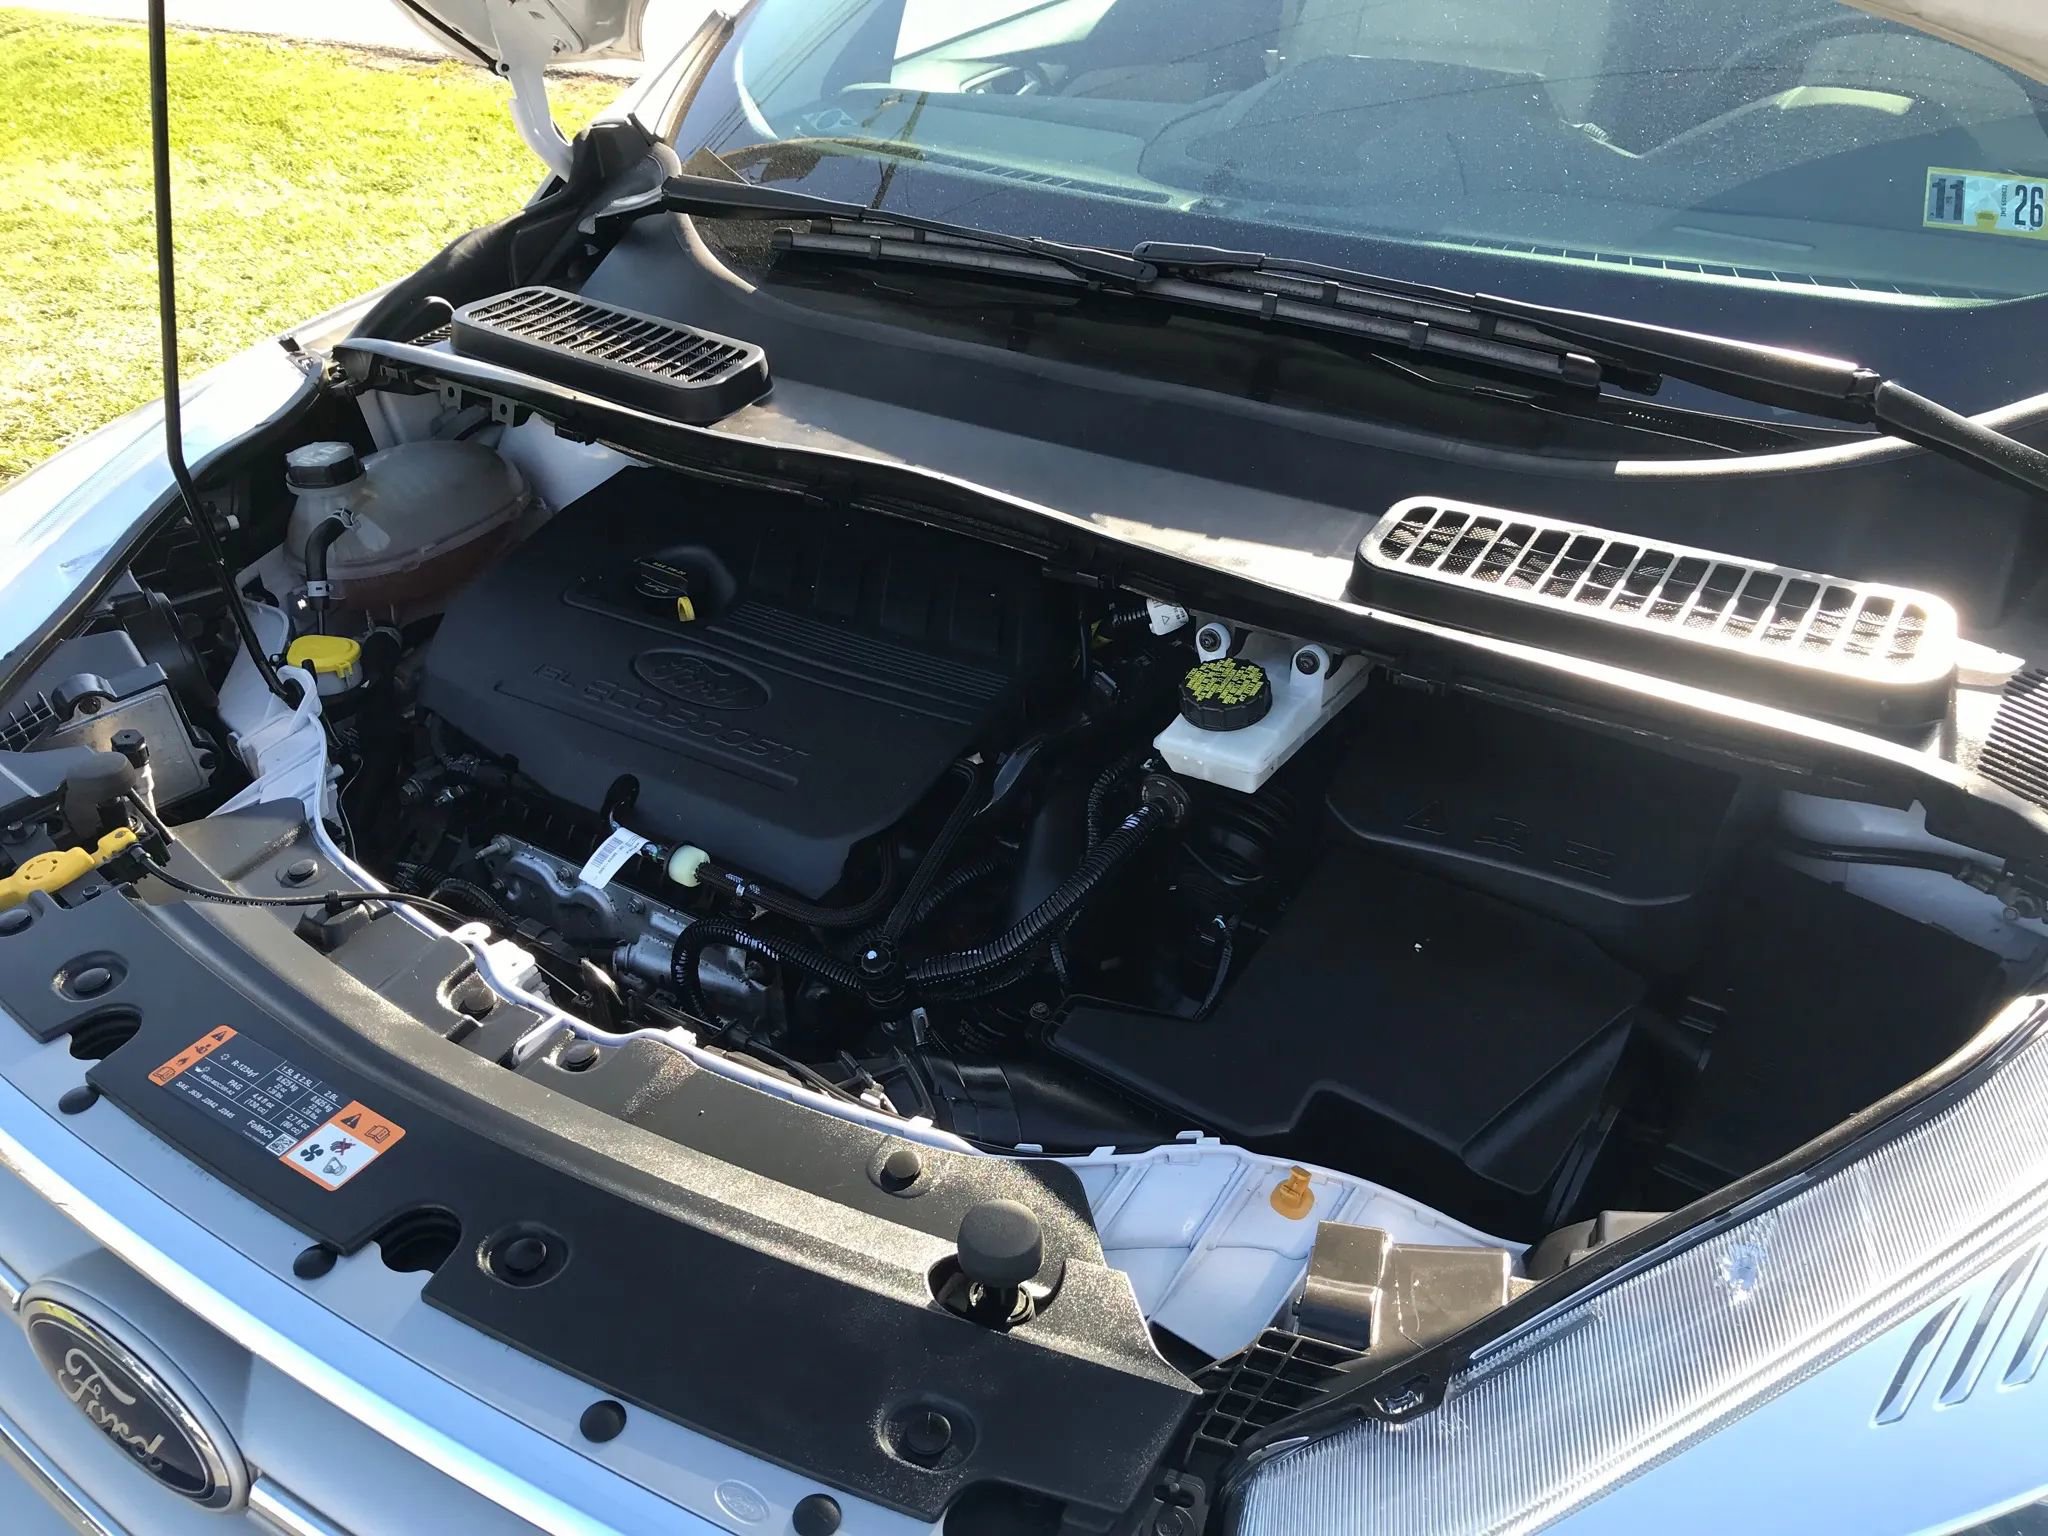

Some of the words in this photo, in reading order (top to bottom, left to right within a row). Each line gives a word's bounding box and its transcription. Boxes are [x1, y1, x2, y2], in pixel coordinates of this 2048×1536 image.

[1932, 178, 1964, 220] 11
[2014, 184, 2044, 228] 26
[649, 656, 748, 705] Ford
[584, 680, 811, 763] ECOBOOST
[229, 1059, 259, 1078] R-1234yf
[279, 1065, 296, 1075] 1.5L
[298, 1076, 314, 1086] 2.5L
[175, 1081, 189, 1090] SAE
[226, 1079, 243, 1090] PAG
[287, 1083, 300, 1092] kg
[255, 1106, 269, 1115] cc)
[285, 1113, 298, 1121] 2.7
[322, 1104, 334, 1112] kg
[246, 1119, 276, 1138] FoMoCo
[288, 1126, 302, 1135] cc)
[57, 1348, 164, 1472] Ford
